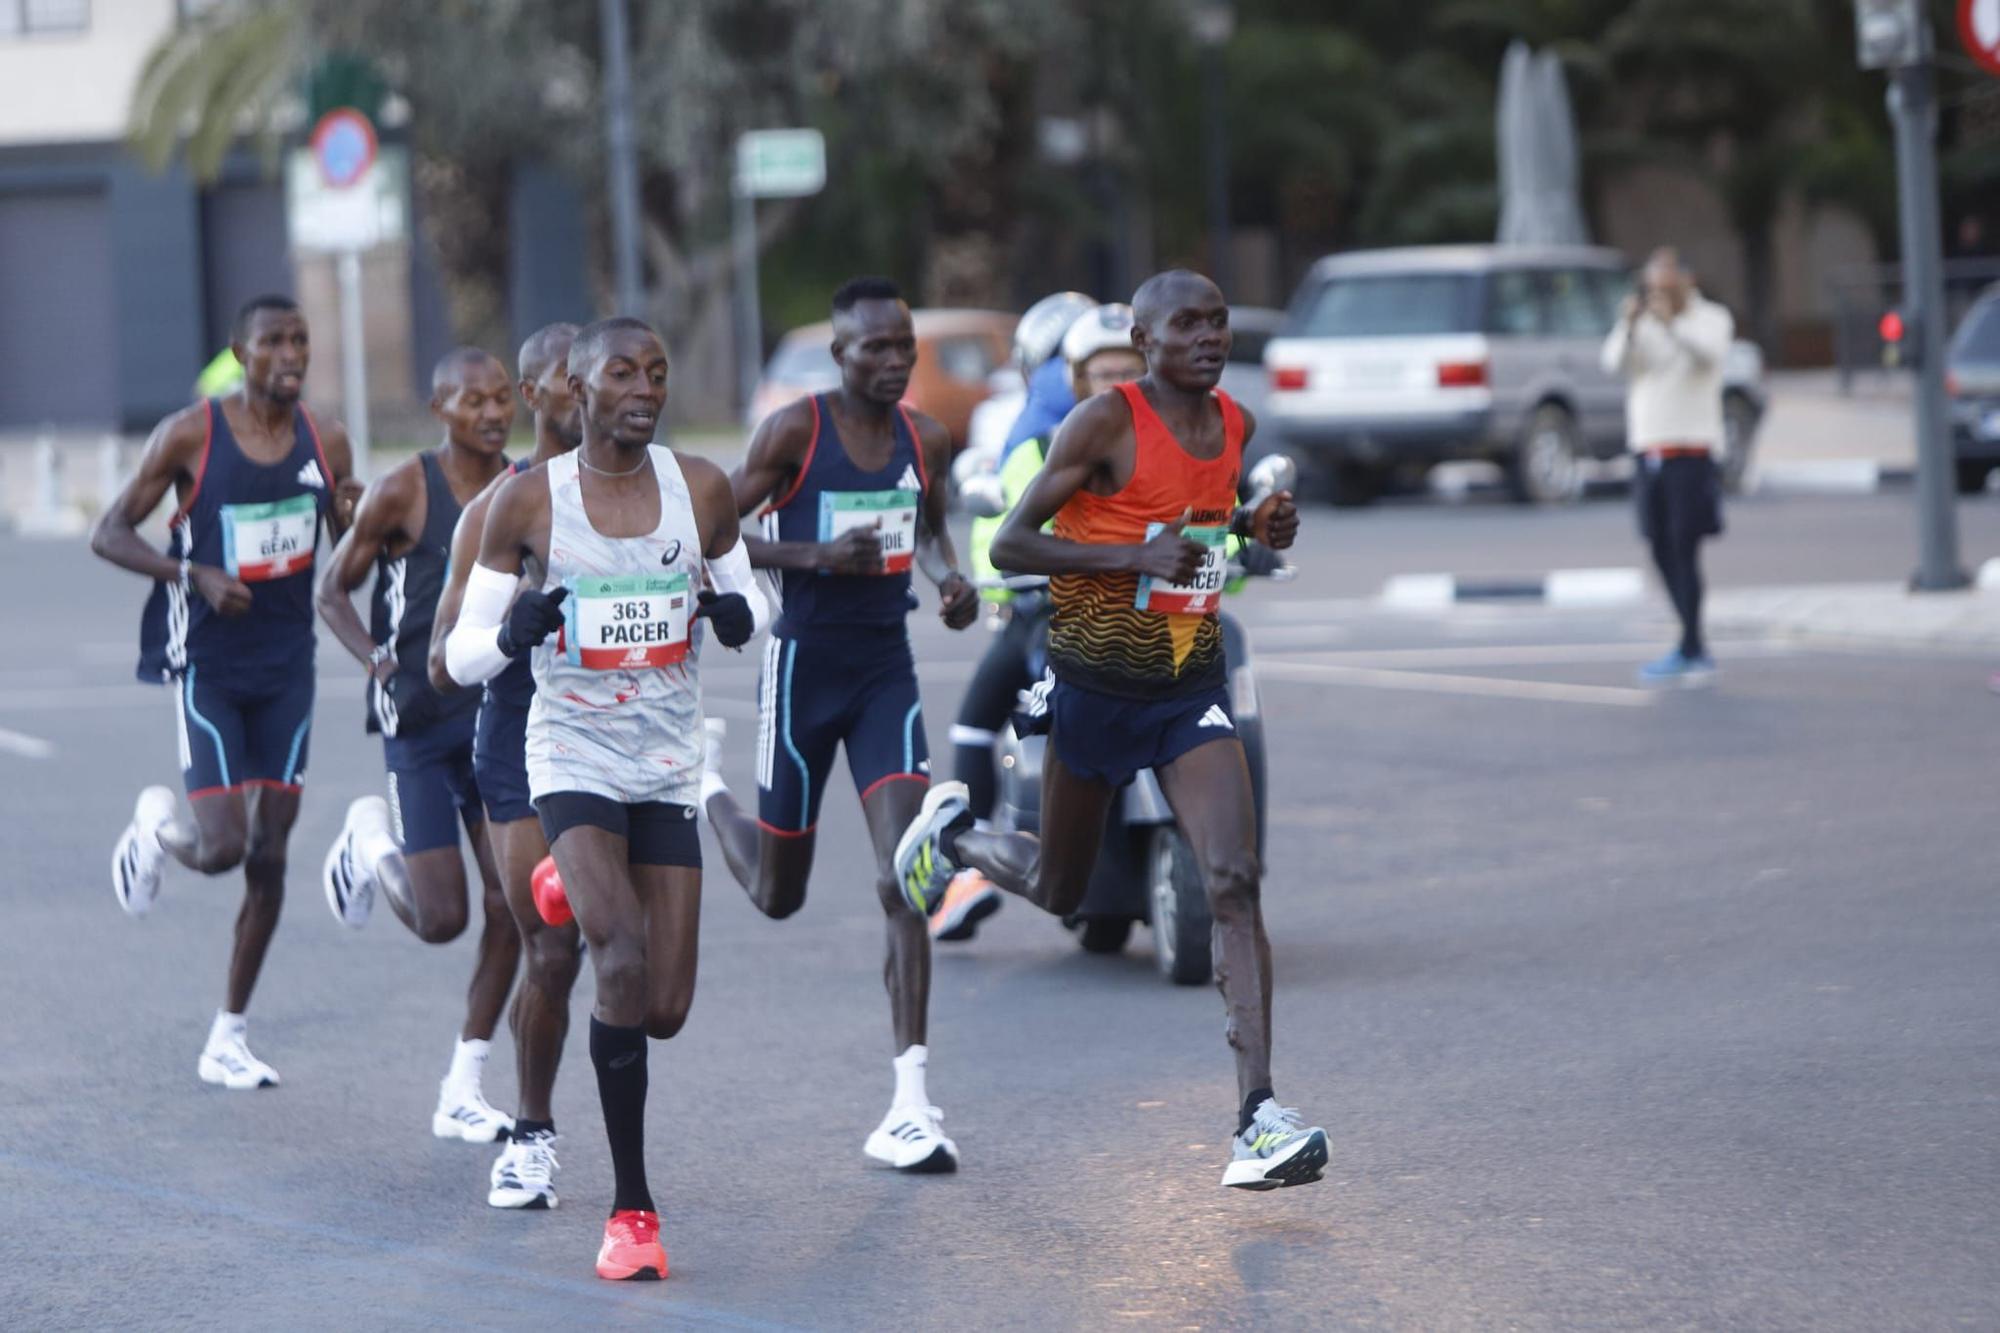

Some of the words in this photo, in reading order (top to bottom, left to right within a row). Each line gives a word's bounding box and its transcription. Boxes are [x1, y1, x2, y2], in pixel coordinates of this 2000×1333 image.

[884, 531, 905, 550] DIE
[612, 601, 650, 621] 363
[601, 621, 670, 643] PACER
